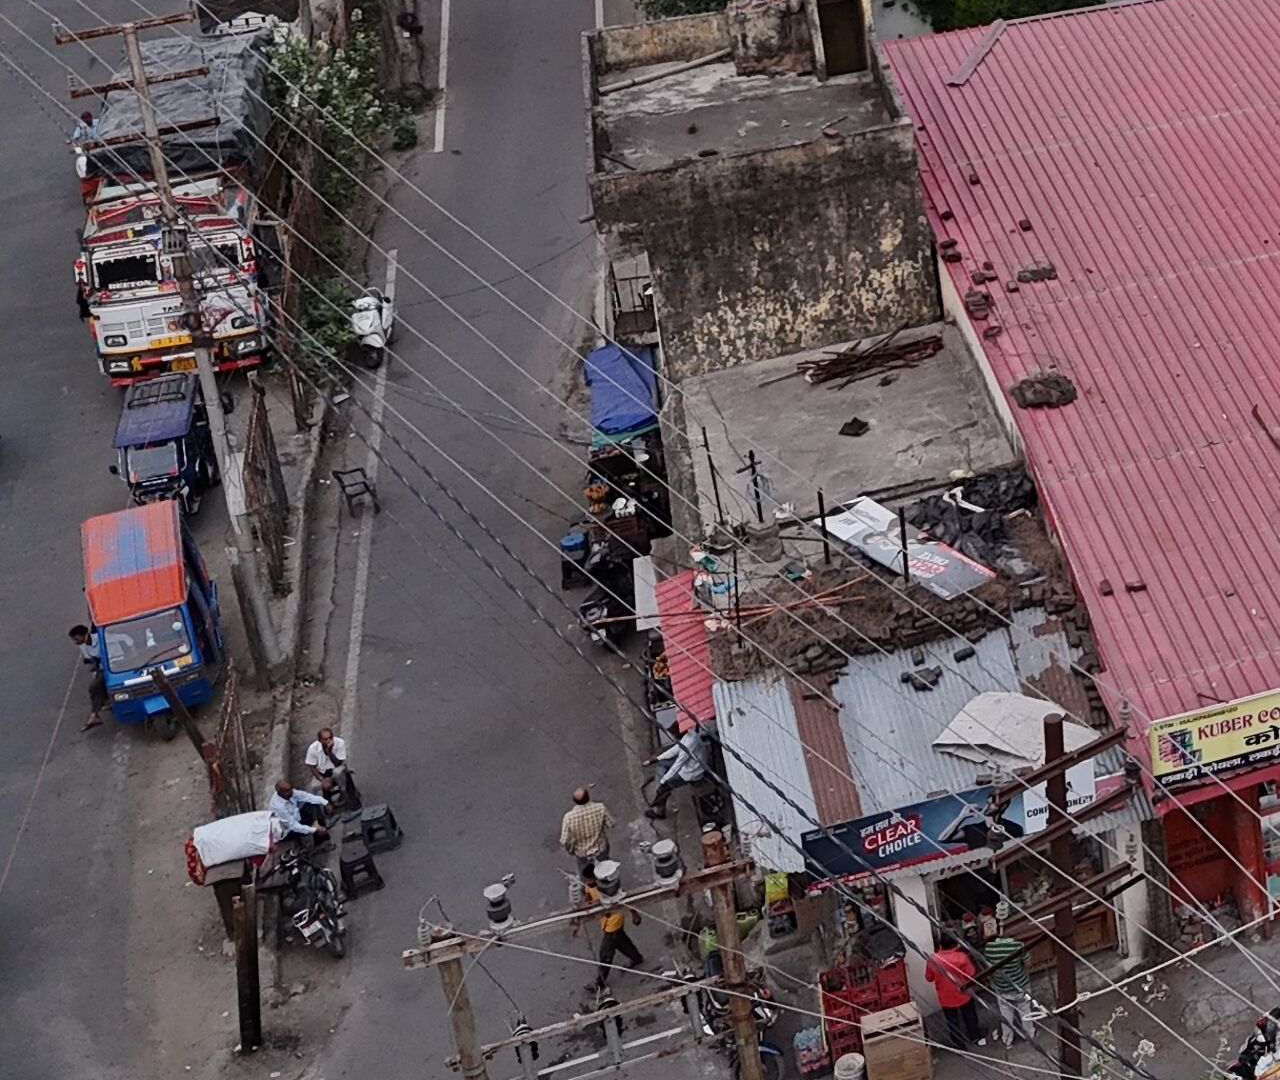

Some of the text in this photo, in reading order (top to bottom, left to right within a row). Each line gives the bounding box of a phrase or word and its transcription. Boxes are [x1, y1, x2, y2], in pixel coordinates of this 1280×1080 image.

[1197, 713, 1253, 741] KUBER
[865, 819, 916, 850] CLEAR
[878, 832, 922, 858] CHOICE
